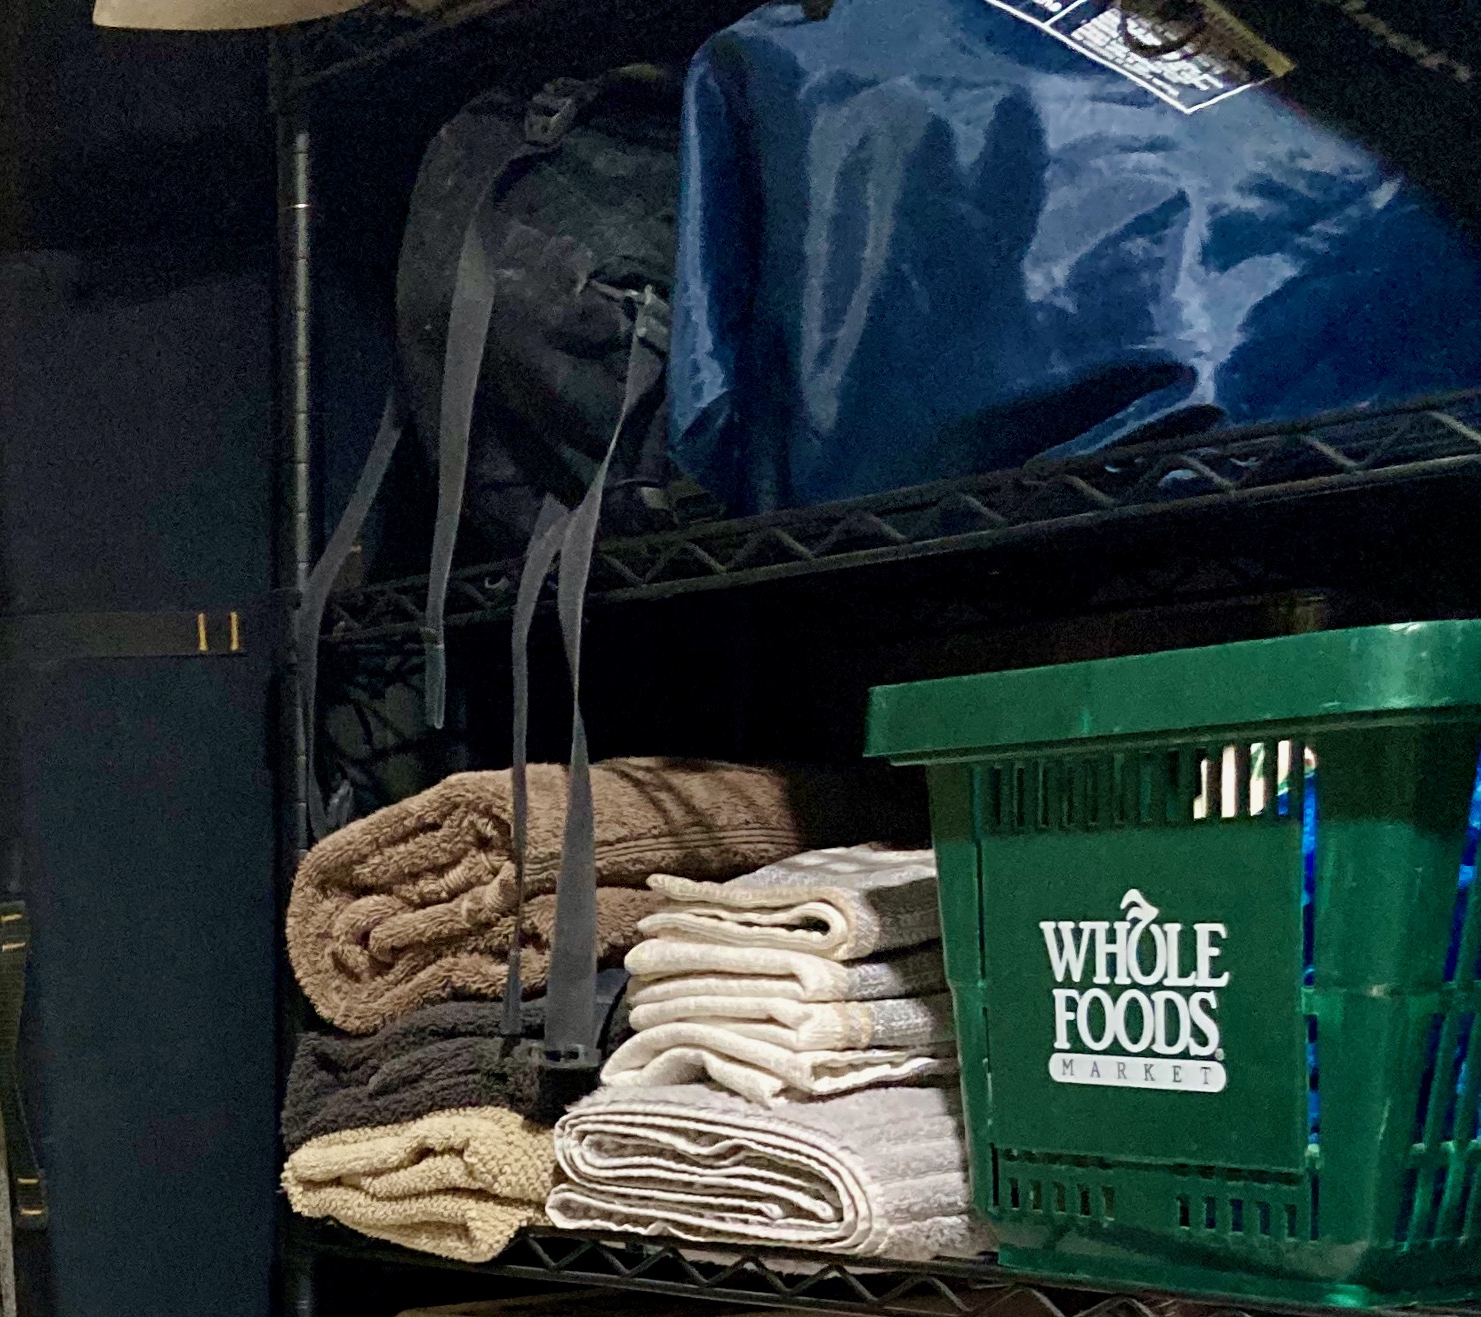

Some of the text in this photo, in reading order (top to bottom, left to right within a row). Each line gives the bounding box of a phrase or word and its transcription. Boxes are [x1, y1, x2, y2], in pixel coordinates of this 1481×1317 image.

[1040, 917, 1230, 988] WHOLE
[1052, 988, 1220, 1057] FOODS
[1060, 1058, 1215, 1087] MARKET
